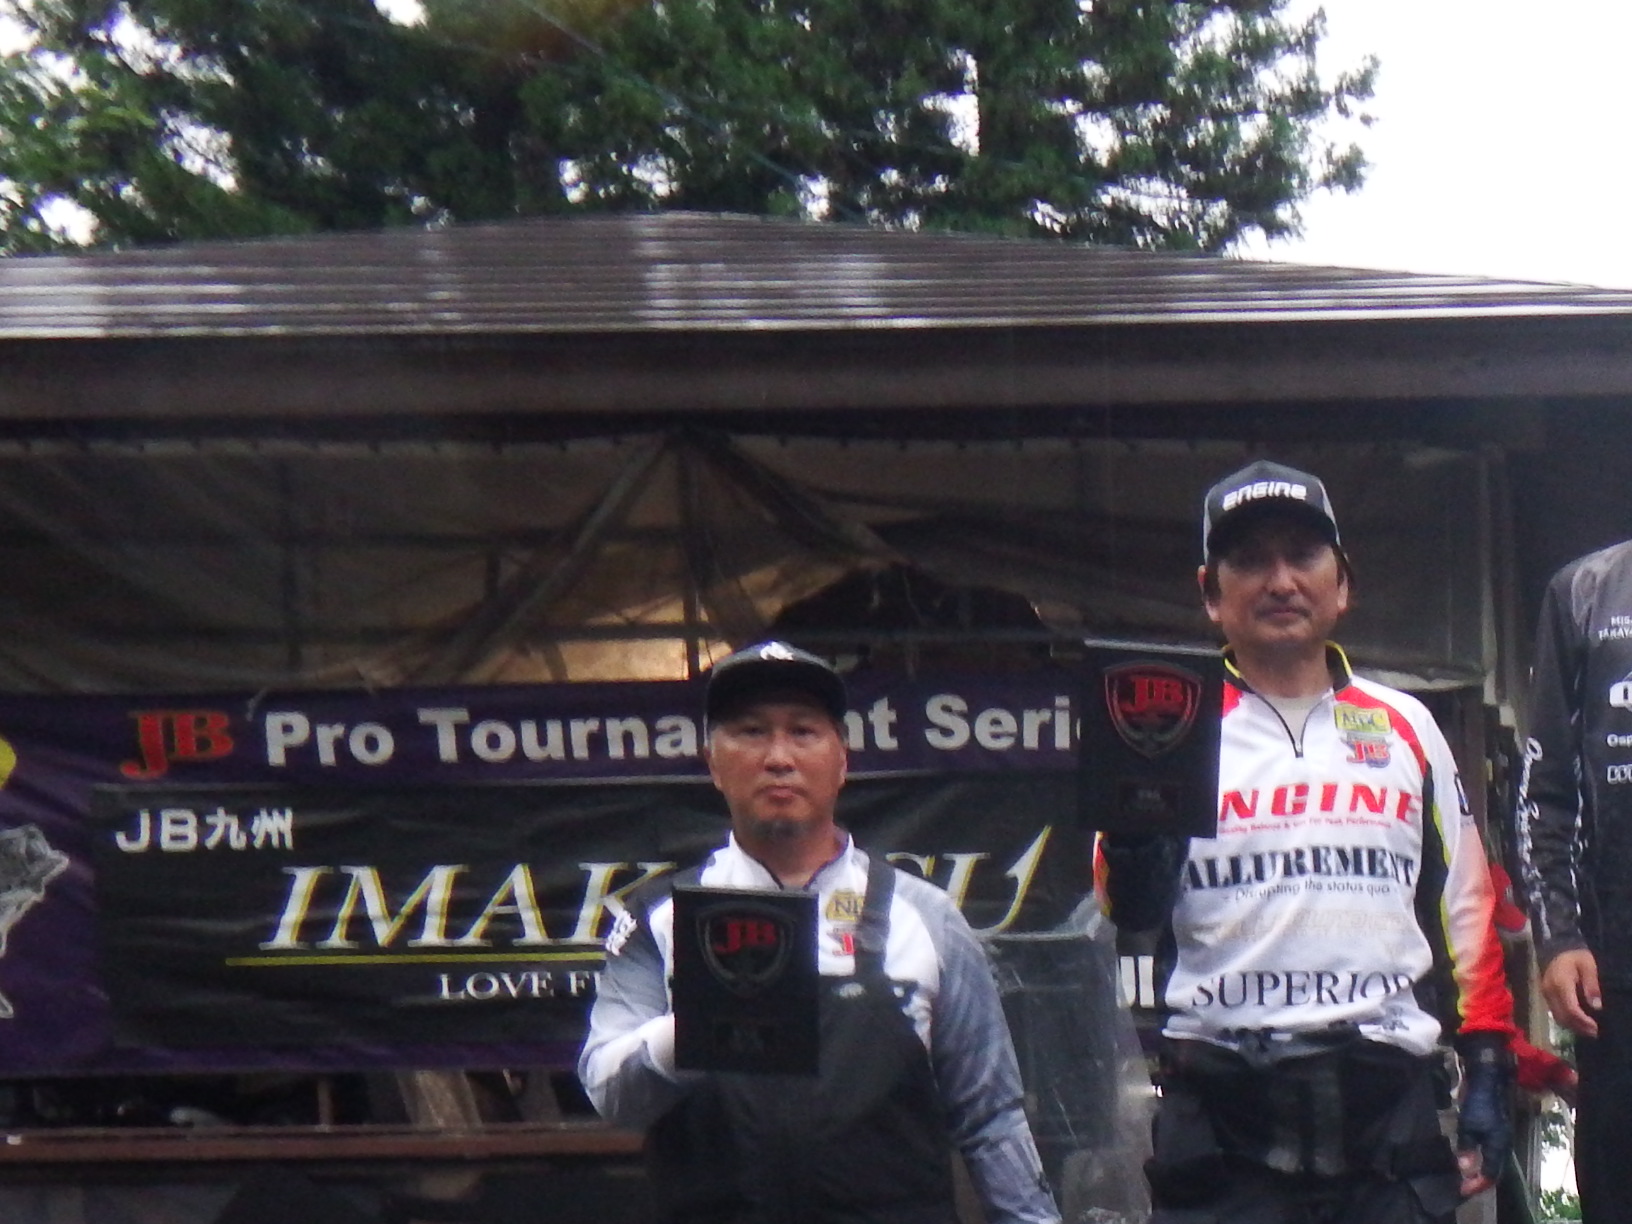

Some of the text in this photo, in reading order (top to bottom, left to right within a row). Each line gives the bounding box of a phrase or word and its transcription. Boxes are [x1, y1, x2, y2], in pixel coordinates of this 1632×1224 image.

[1222, 480, 1307, 512] engine
[1122, 675, 1187, 714] JB
[120, 693, 1081, 779] JB Pro Tournant Seri
[1219, 781, 1424, 825] NGINE
[116, 807, 295, 853] JB九州
[1183, 845, 1415, 892] ALLUREMENT
[1304, 878, 1323, 892] the
[1326, 882, 1363, 893] status
[711, 914, 777, 956] JB
[439, 972, 554, 1000] LOVE
